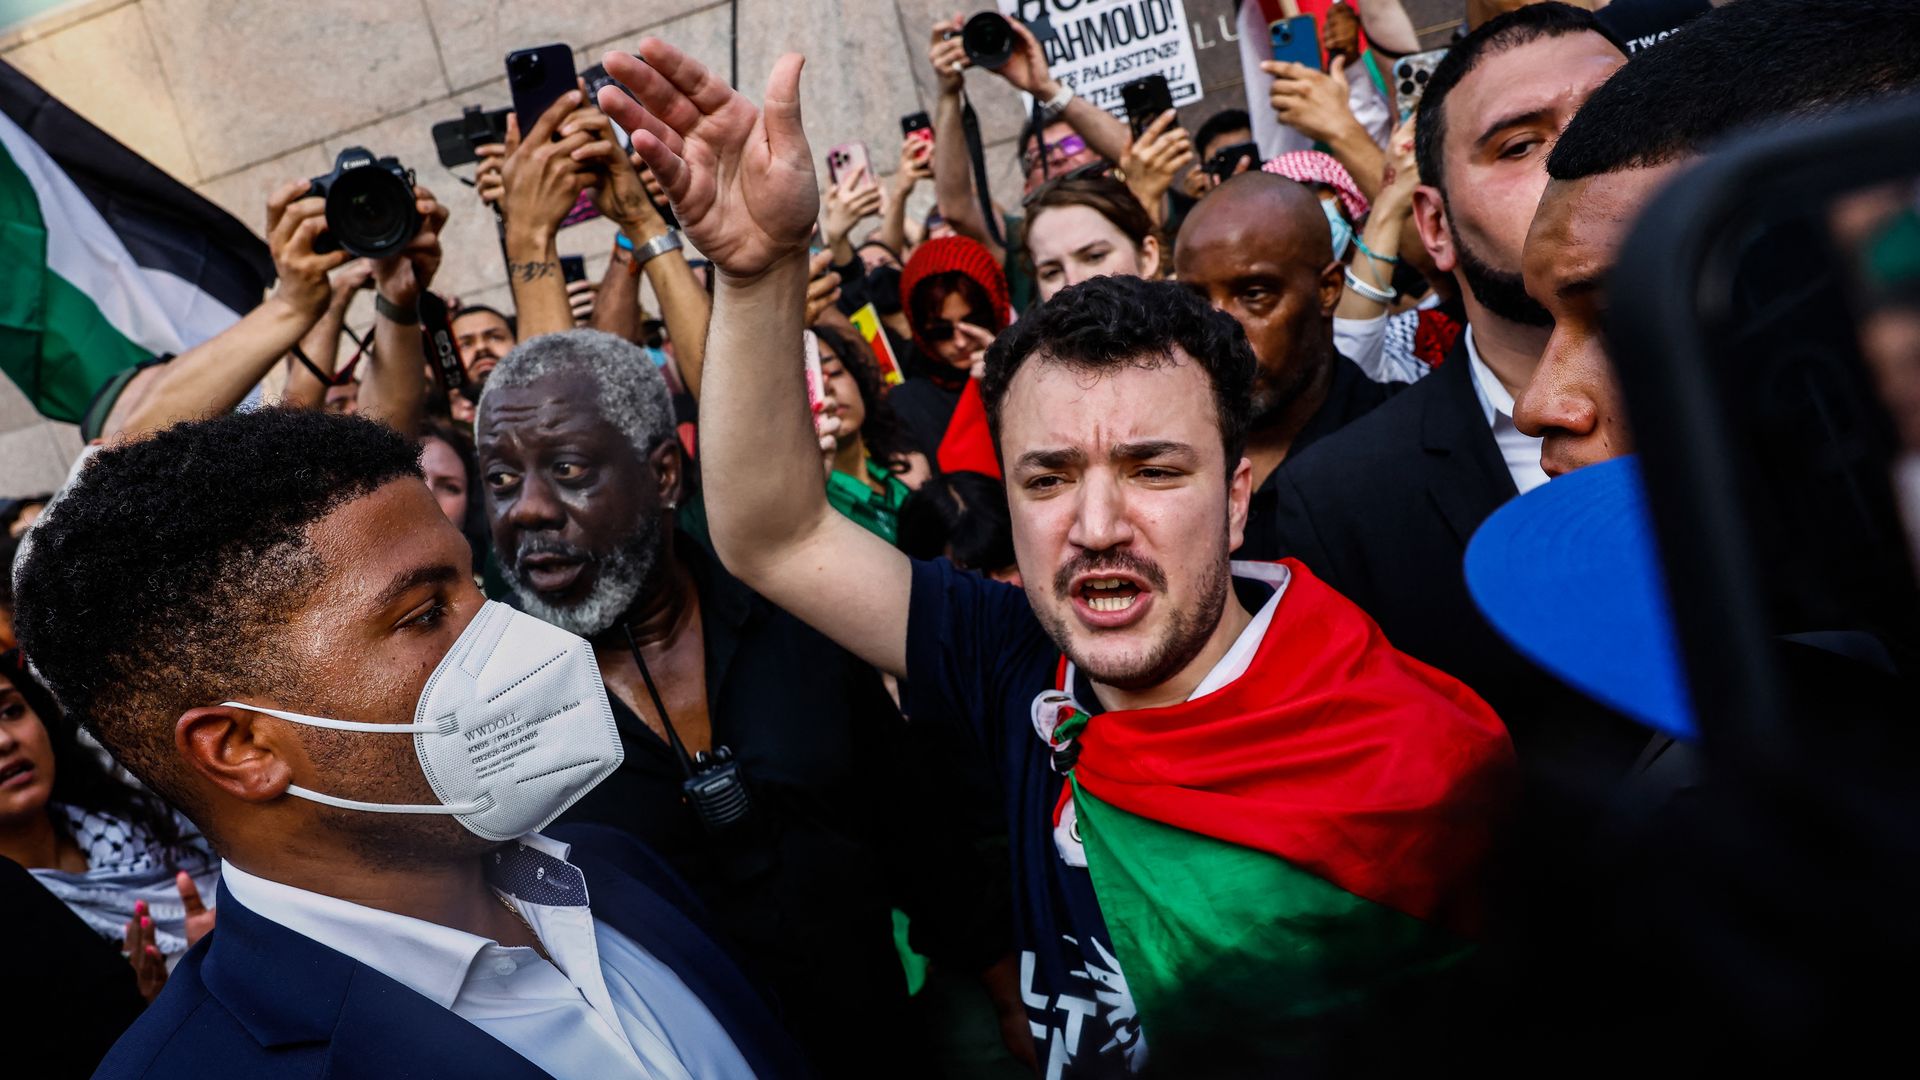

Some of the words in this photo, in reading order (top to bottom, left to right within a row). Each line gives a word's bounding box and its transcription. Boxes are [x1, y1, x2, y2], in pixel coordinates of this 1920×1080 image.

[342, 158, 370, 170] Canon
[435, 329, 457, 368] EOS
[464, 713, 520, 742] WWDOLL
[468, 740, 490, 754] KN95
[526, 709, 562, 729] Protective
[562, 700, 582, 713] Mask
[519, 730, 539, 745] KN95
